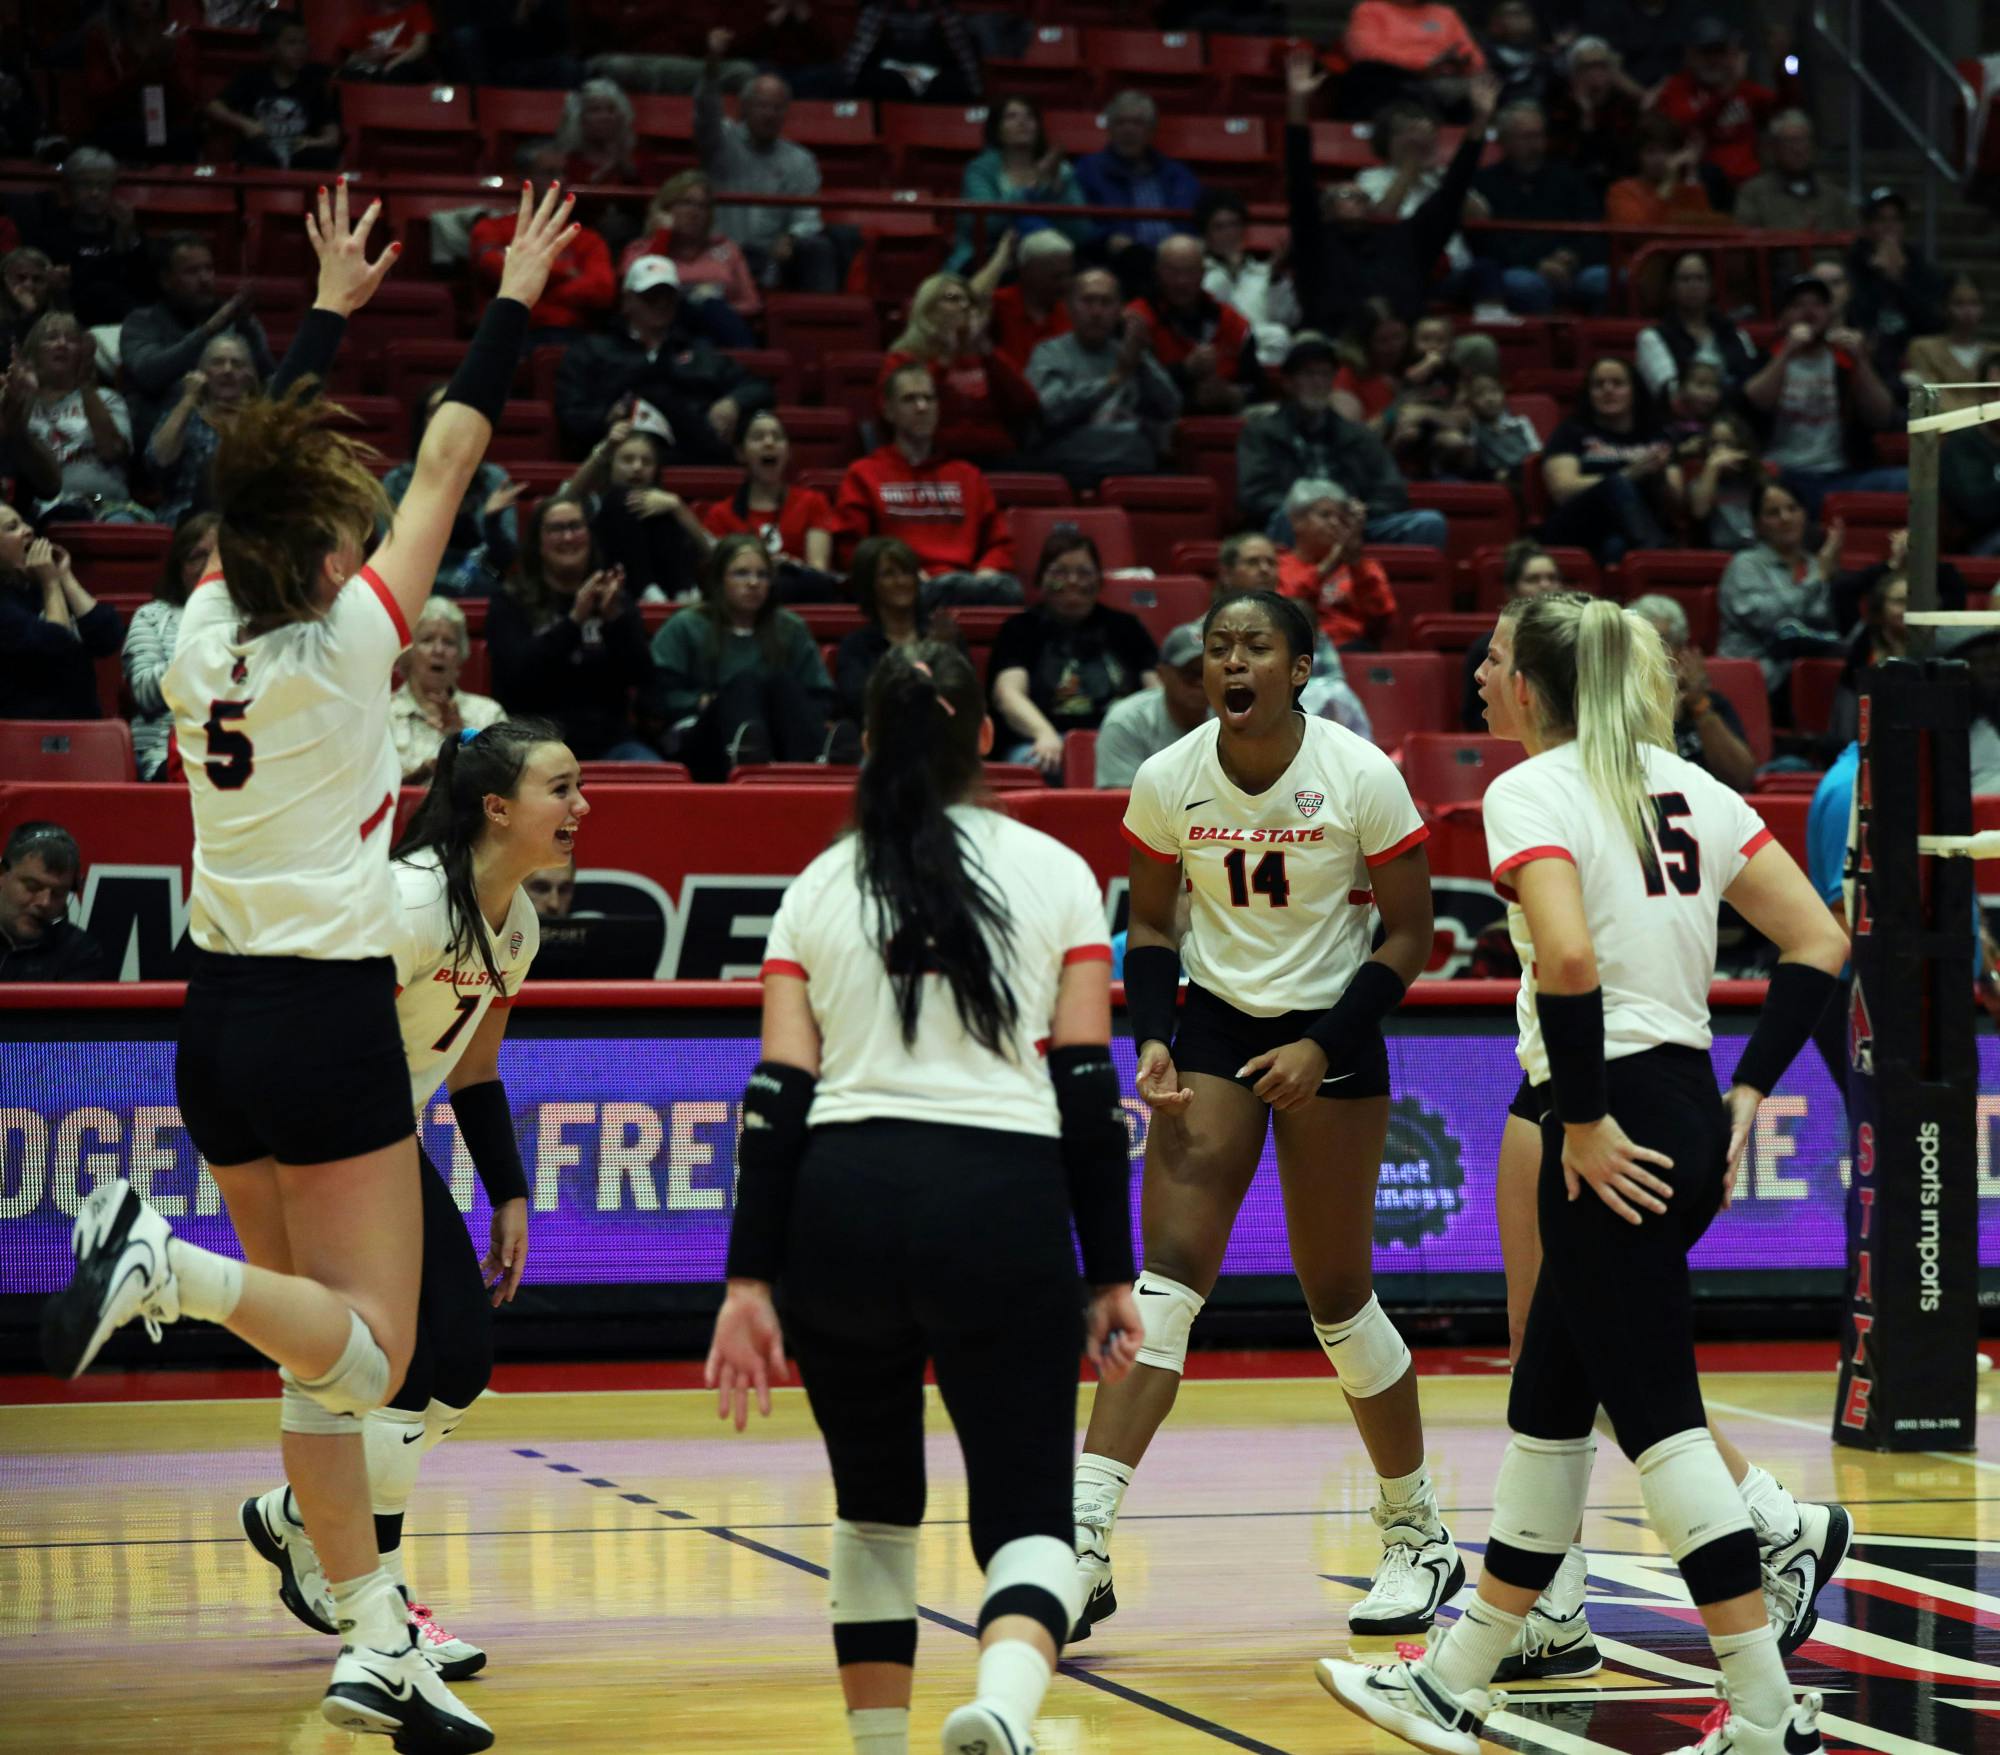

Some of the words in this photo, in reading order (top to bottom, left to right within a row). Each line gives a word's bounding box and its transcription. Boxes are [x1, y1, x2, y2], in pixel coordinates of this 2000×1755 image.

[203, 699, 254, 791] 5
[1188, 826, 1245, 841] BALL
[1250, 826, 1325, 843] STATE
[1223, 847, 1290, 908] 14
[1636, 791, 1701, 897] 15
[533, 1101, 744, 1212] FRE
[1378, 1159, 1431, 1185] net
[1915, 1121, 1943, 1206] sports
[1915, 1208, 1942, 1312] imports
